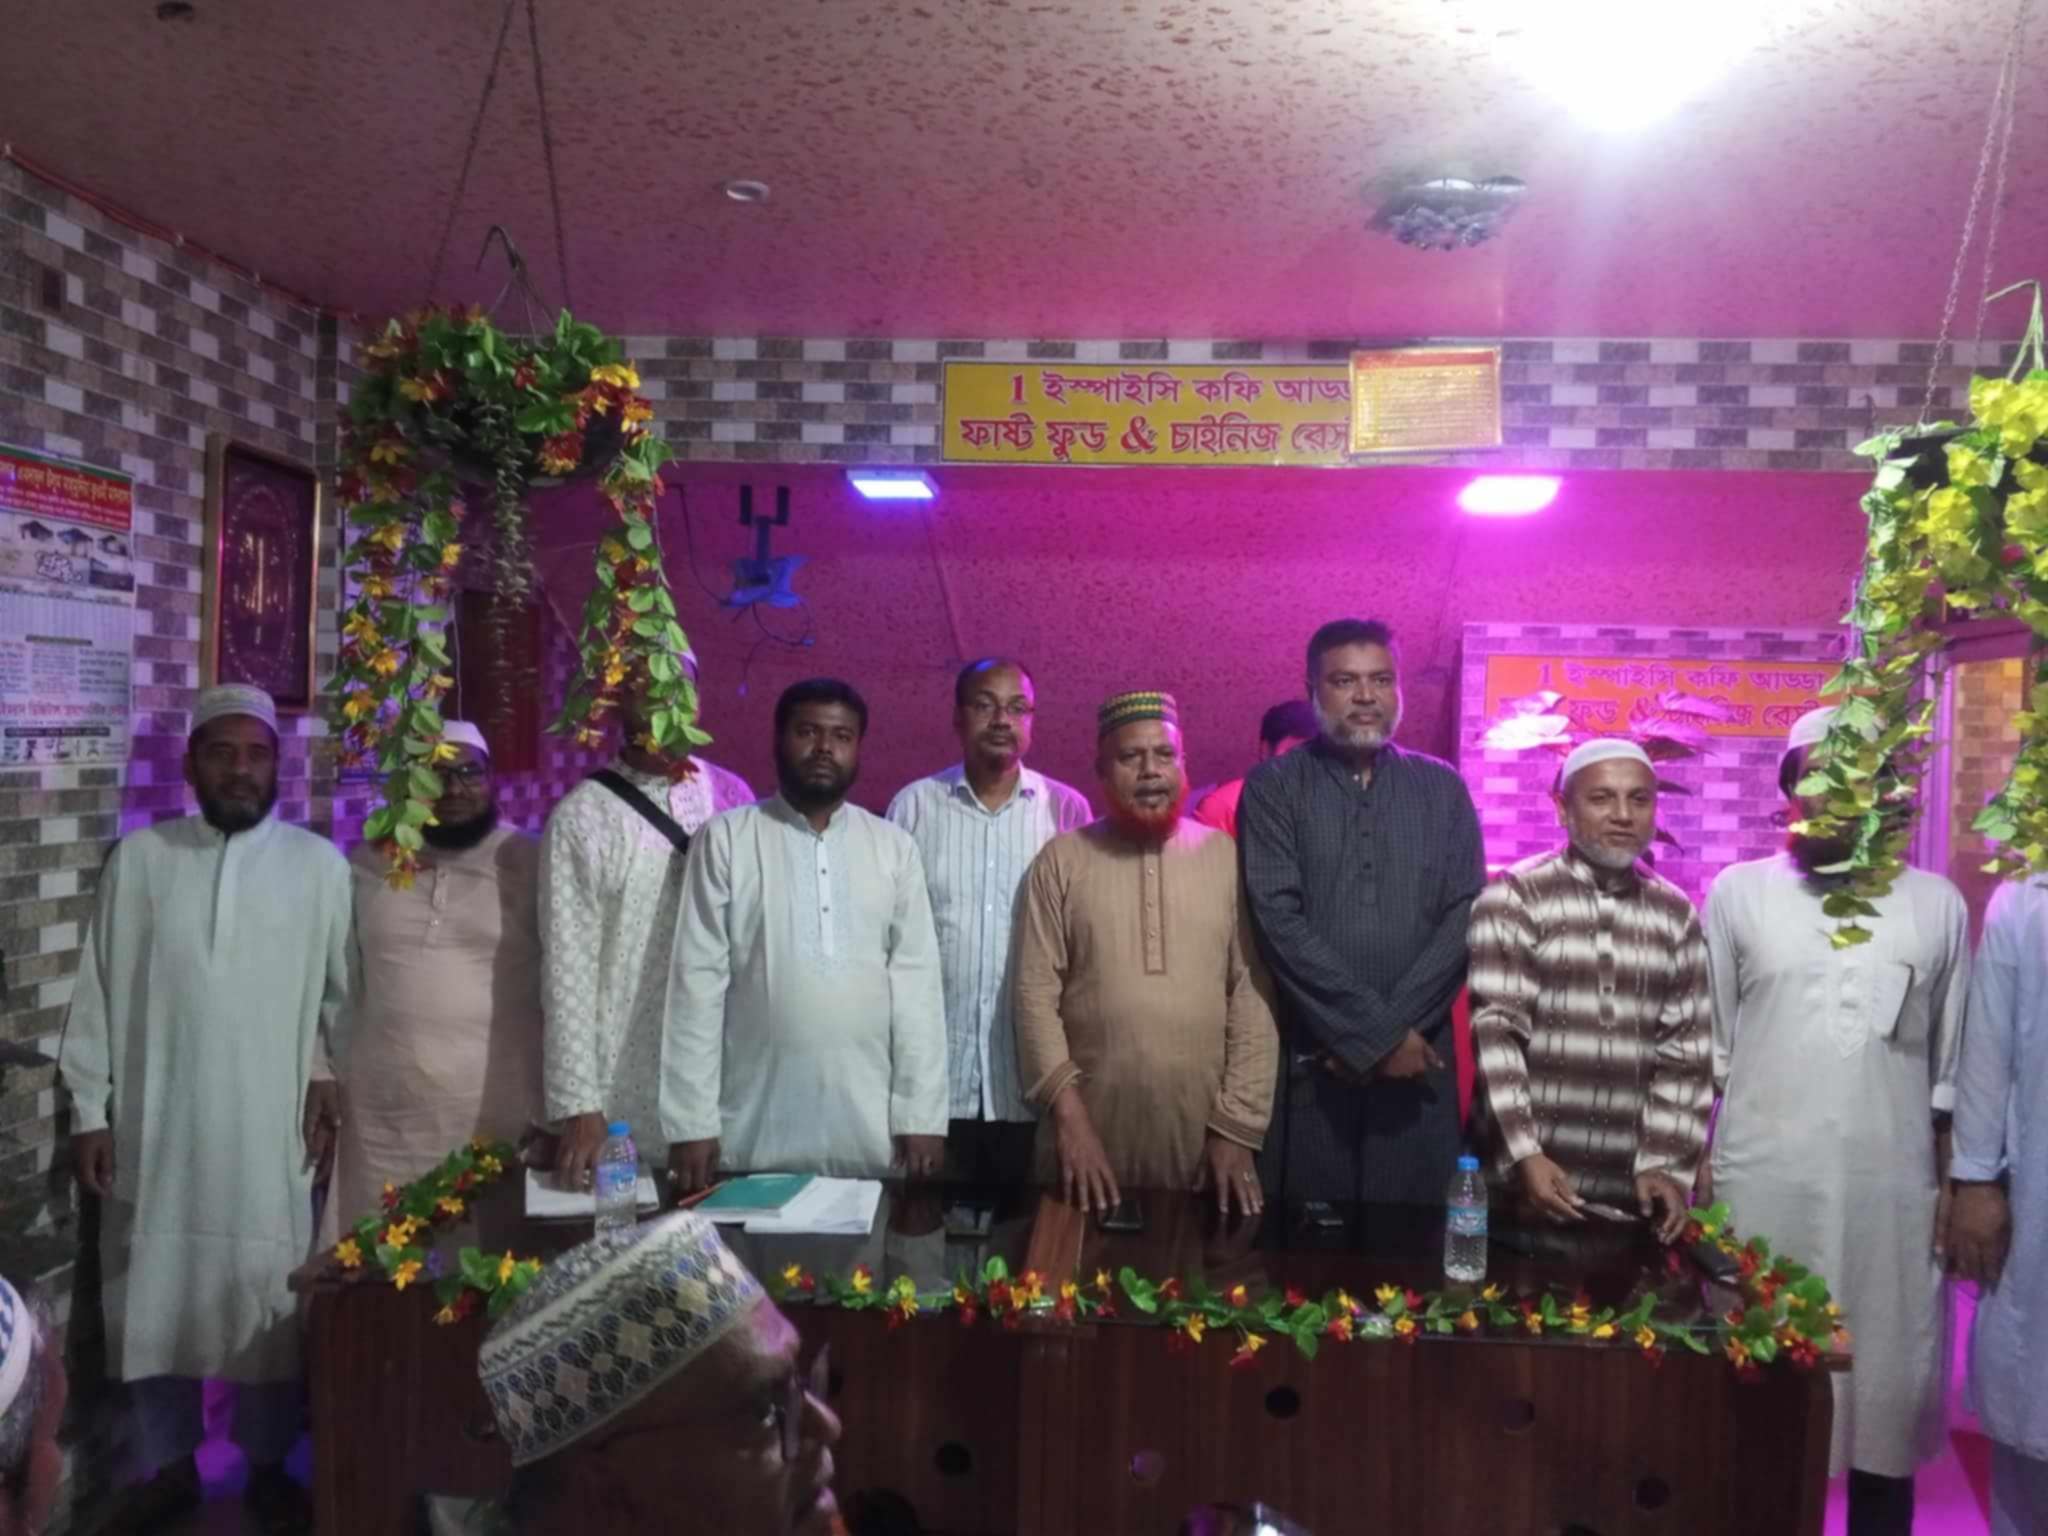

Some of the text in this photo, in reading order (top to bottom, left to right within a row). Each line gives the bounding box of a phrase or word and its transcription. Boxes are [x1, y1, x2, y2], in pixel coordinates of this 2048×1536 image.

[1191, 370, 1263, 403] কফি
[1045, 420, 1109, 463] ফুড
[1120, 415, 1153, 451] &
[1169, 411, 1283, 455] চাইনিজ
[1686, 664, 1740, 689] কফি
